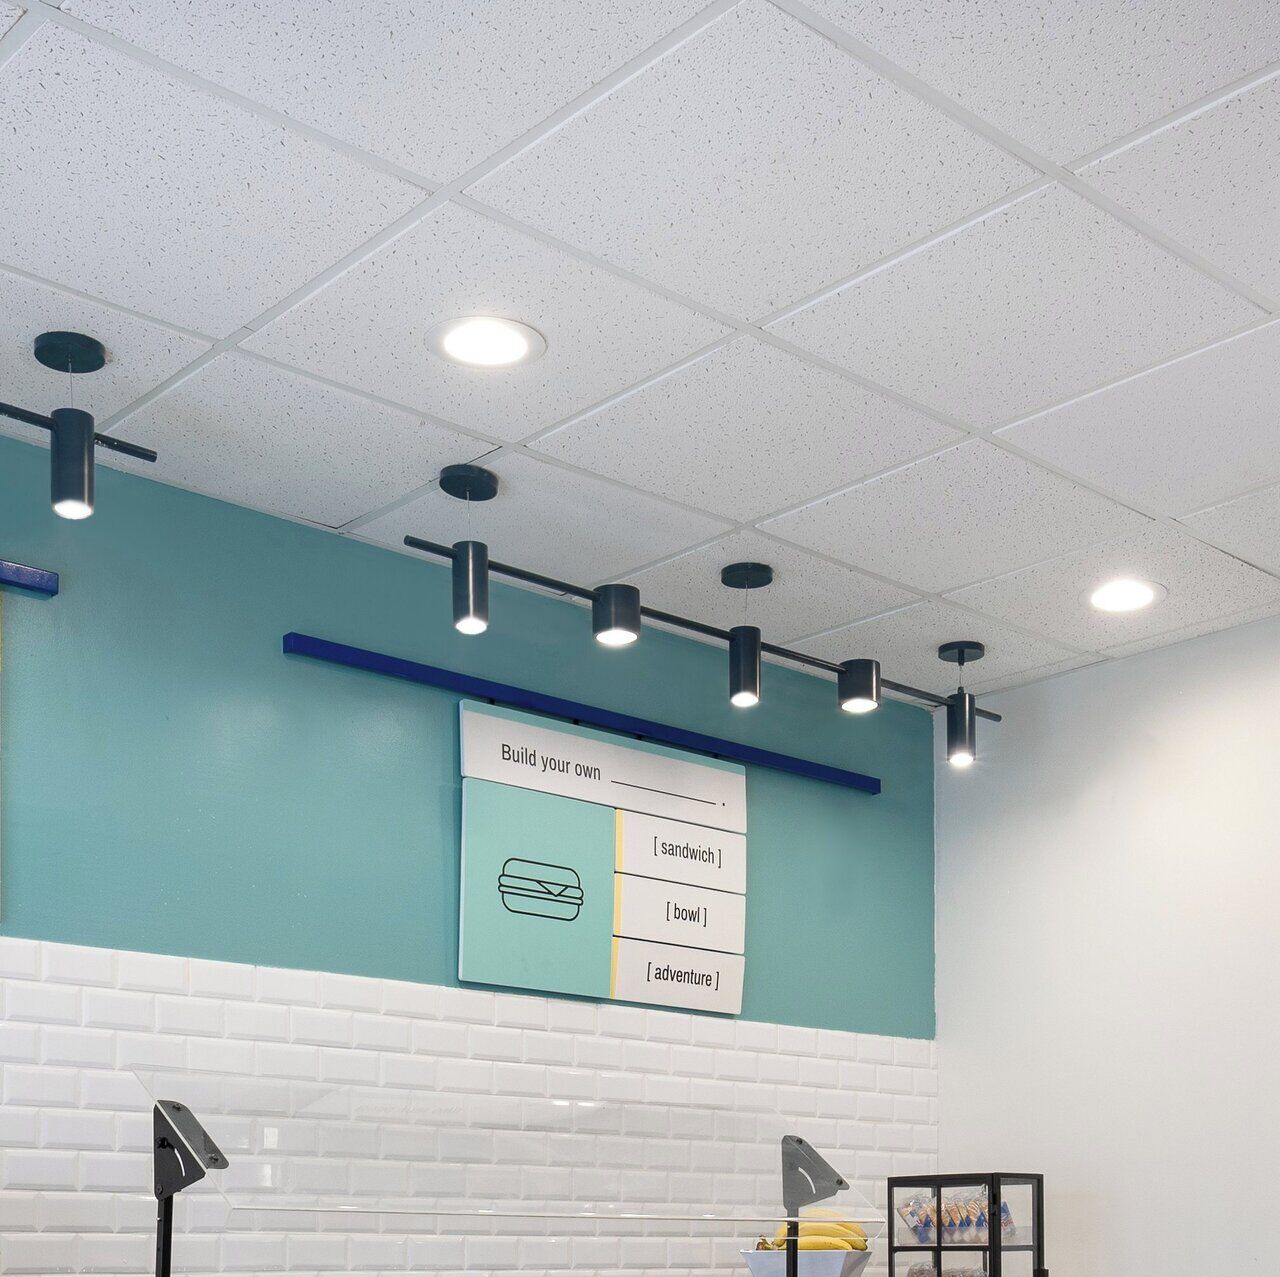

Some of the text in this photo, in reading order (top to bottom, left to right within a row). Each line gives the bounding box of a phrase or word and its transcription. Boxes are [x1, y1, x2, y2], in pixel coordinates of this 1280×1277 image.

[501, 743, 601, 781] Build your own
[661, 841, 715, 865] sandwich
[673, 902, 701, 923] bowl
[654, 964, 713, 987] adventure
